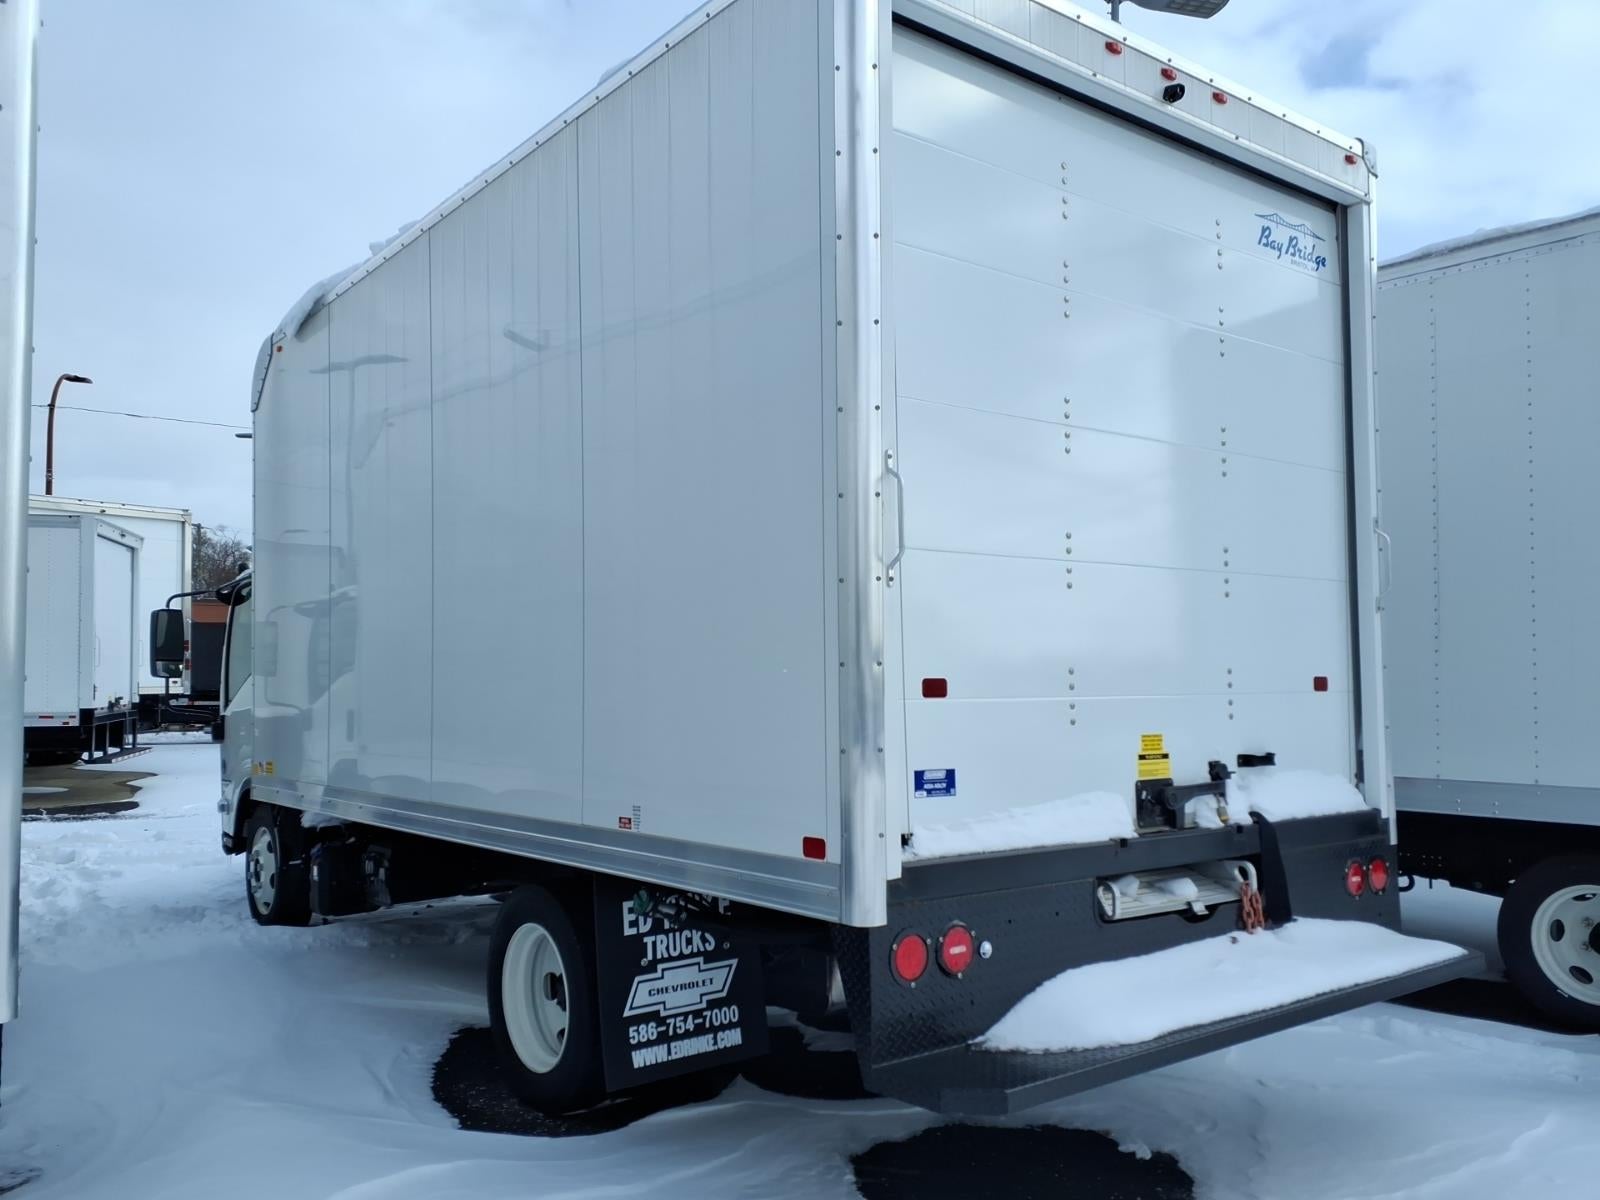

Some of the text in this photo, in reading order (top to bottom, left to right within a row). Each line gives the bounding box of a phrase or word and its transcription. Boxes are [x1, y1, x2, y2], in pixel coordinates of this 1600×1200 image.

[1258, 225, 1326, 272] Bay Bridge
[643, 929, 716, 961] TRUCKS
[648, 977, 714, 997] CHEVROLET
[628, 1005, 739, 1045] 586-754-7000
